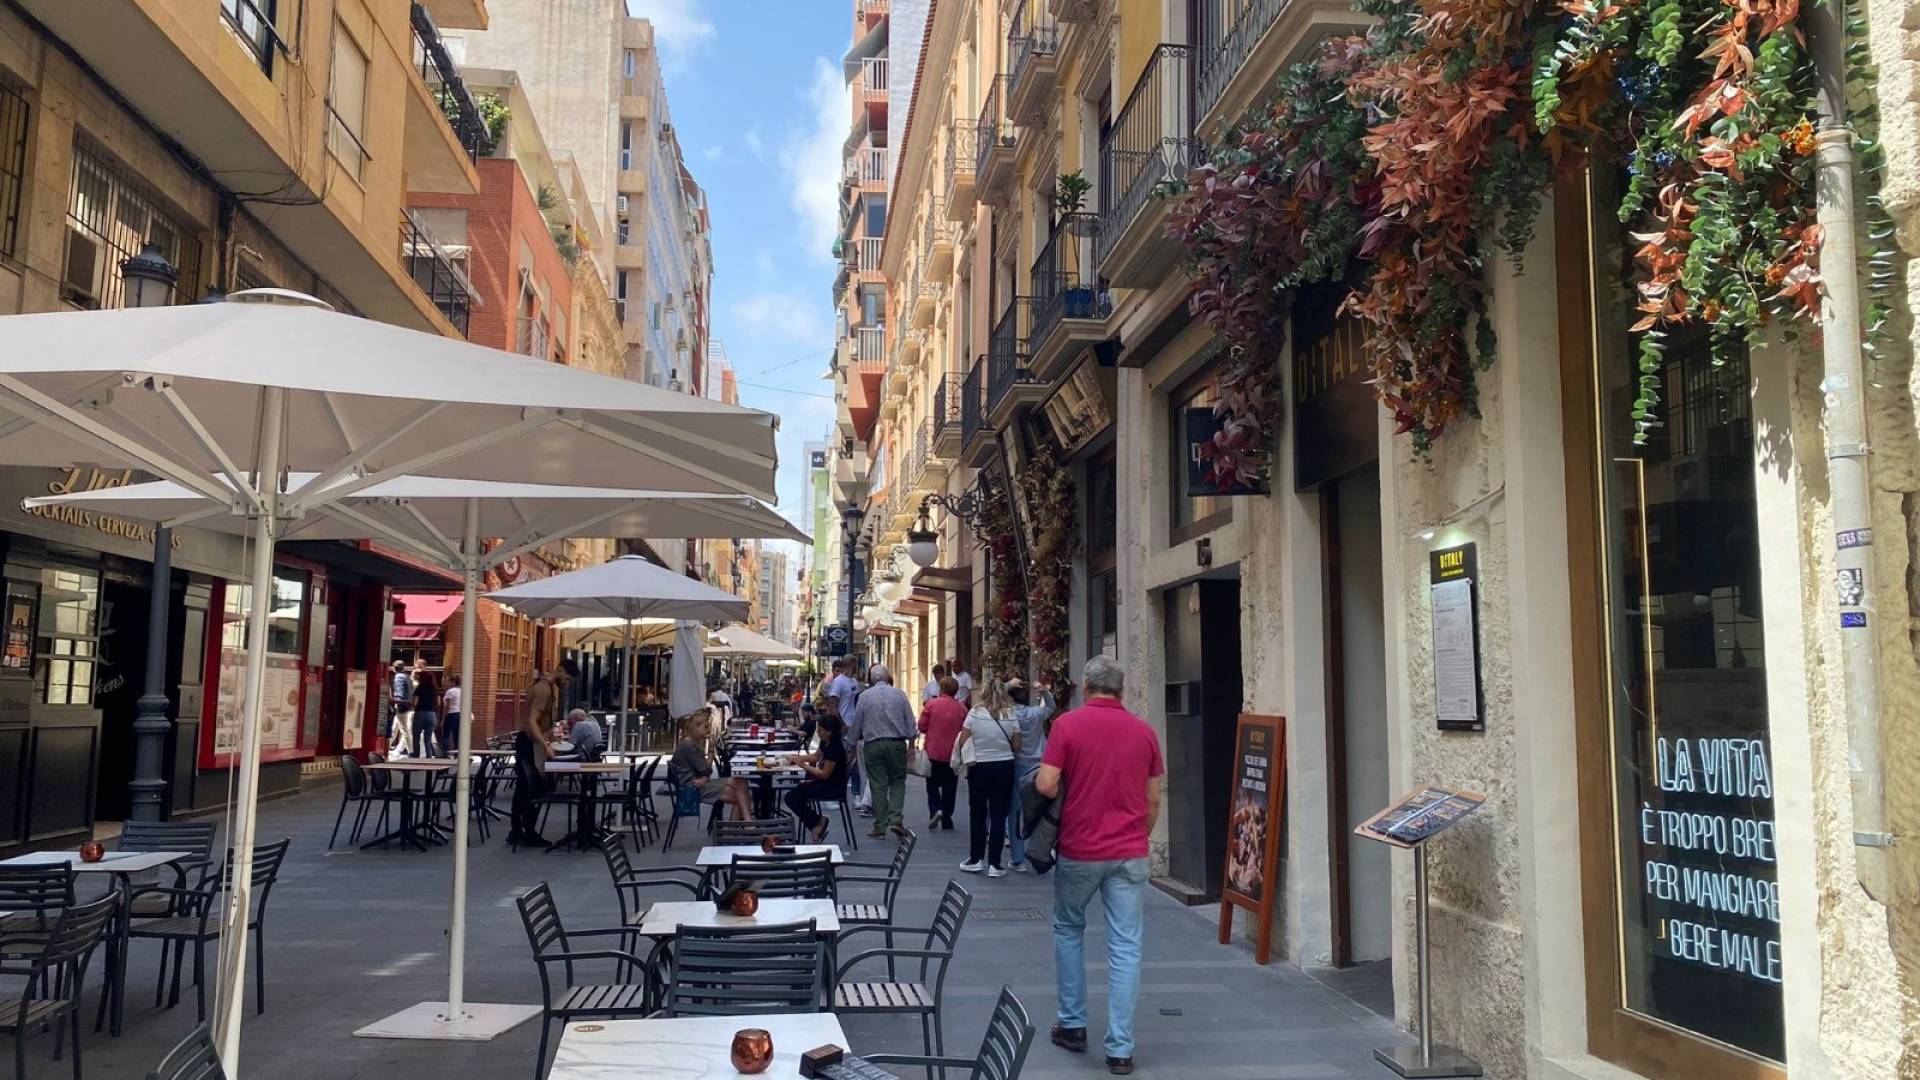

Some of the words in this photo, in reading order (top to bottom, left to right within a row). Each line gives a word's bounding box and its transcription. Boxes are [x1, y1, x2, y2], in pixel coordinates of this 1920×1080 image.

[99, 515, 144, 541] CERVEZA
[1658, 737, 1695, 792] LA
[1699, 737, 1771, 798] VITA
[1643, 801, 1657, 845] È
[1657, 810, 1727, 854] TROPPO
[1646, 860, 1681, 902] PER
[1683, 868, 1780, 922] MANGIARE
[1670, 918, 1721, 966] BERE
[1721, 929, 1782, 983] MALE
